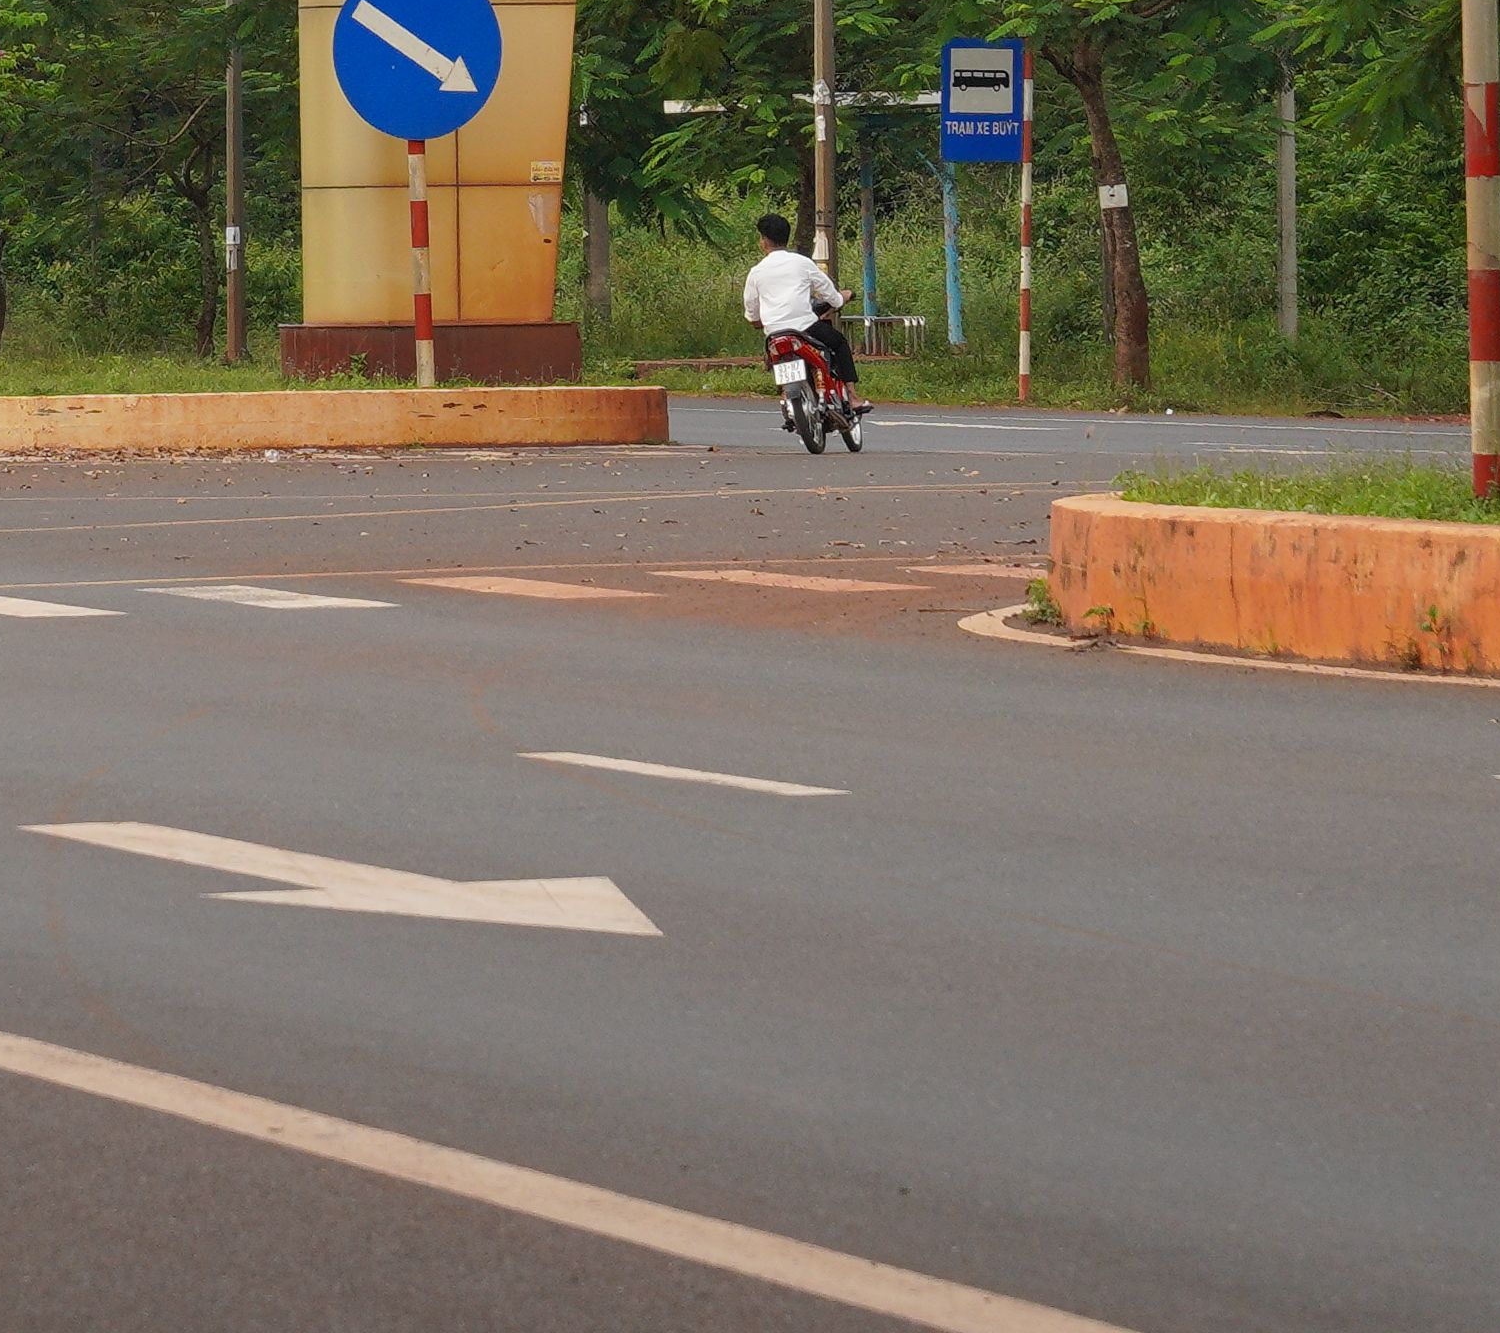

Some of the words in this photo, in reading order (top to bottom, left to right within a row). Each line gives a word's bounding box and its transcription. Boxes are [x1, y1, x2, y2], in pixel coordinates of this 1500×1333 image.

[945, 120, 974, 137] TRẠM
[976, 121, 990, 135] XE
[992, 119, 1020, 136] BUÝT
